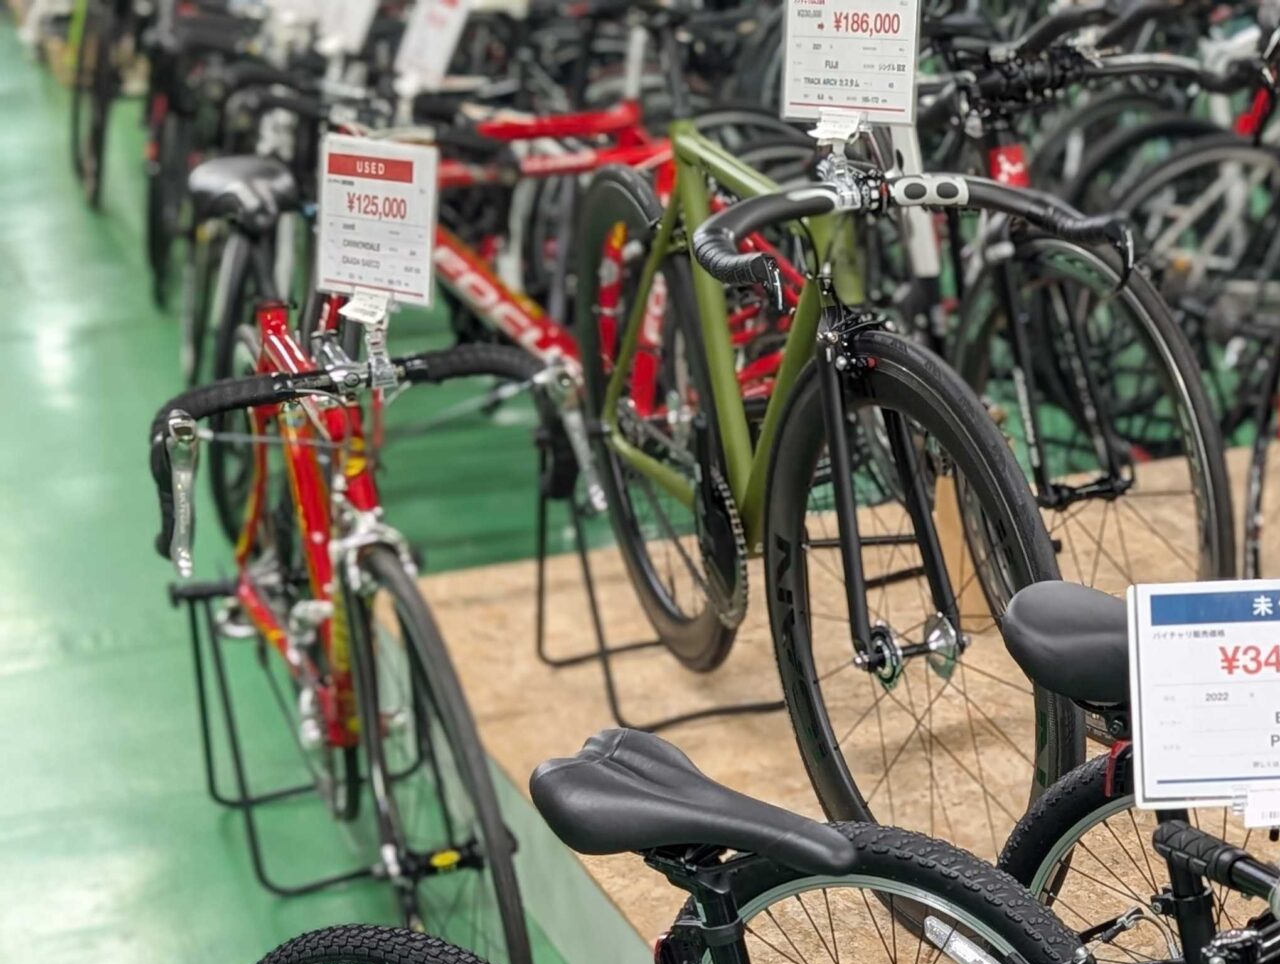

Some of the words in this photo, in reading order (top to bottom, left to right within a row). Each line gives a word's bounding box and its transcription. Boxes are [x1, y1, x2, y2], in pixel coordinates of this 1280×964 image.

[833, 11, 902, 37] ¥186,000
[356, 160, 386, 175] USED
[346, 192, 408, 220] ¥125,000
[1205, 692, 1229, 702] 2022
